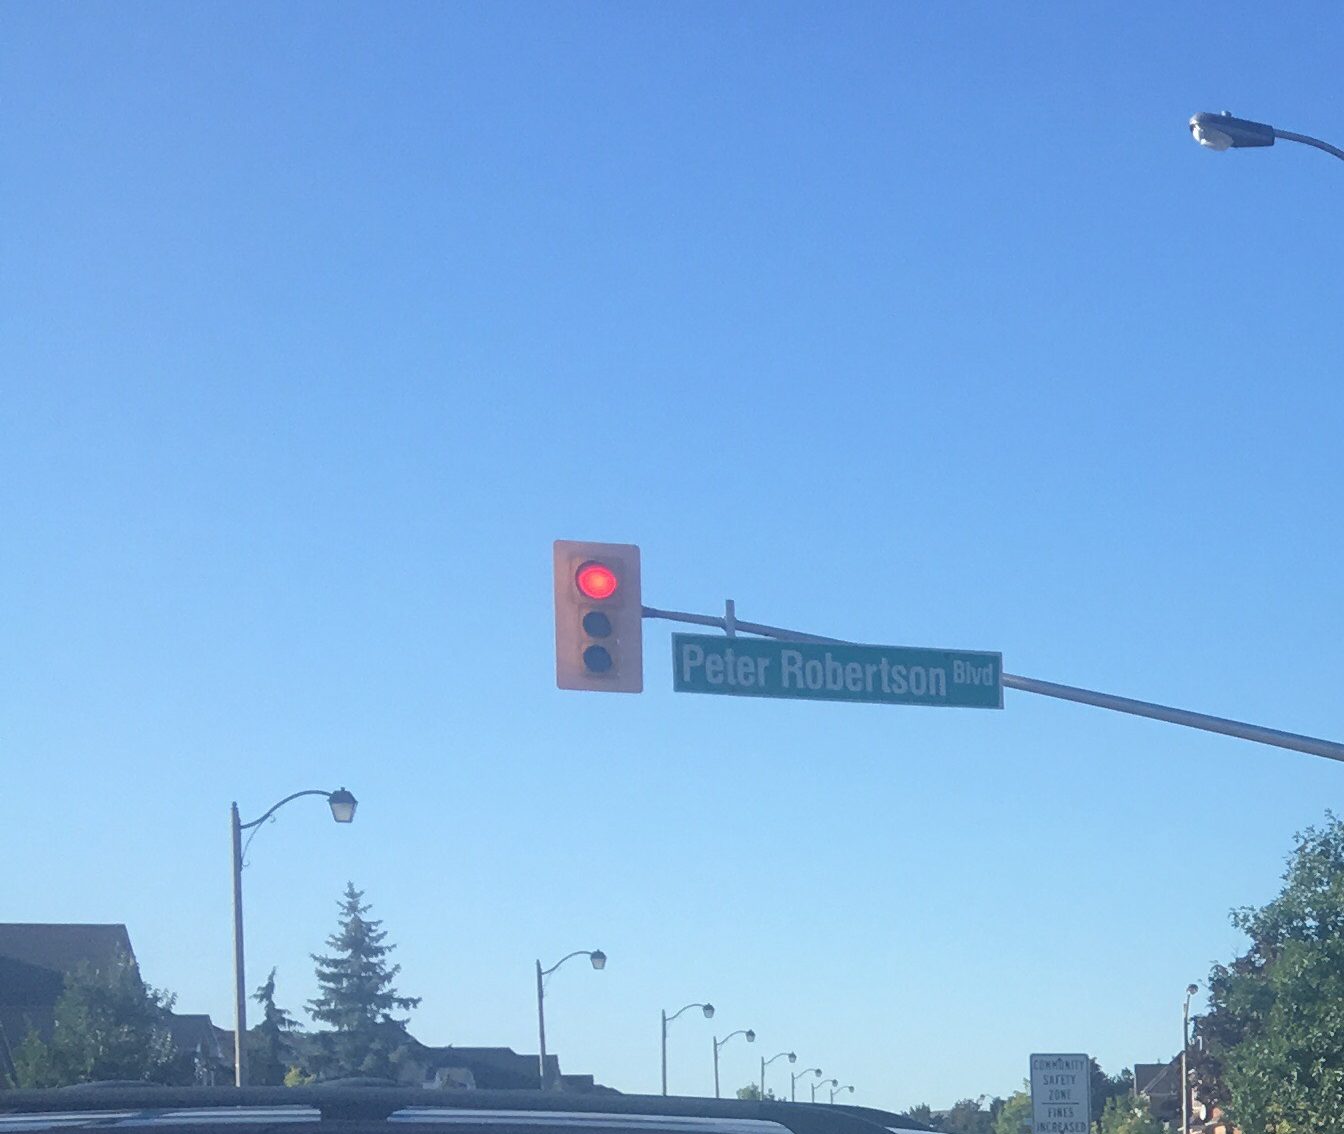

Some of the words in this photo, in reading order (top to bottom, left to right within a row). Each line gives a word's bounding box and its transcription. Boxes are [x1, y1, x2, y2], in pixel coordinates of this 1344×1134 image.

[682, 643, 771, 687] Peter
[781, 649, 947, 697] Robertson
[953, 659, 994, 687] Blvd
[1033, 1060, 1085, 1070] COMMUNITY
[1043, 1074, 1077, 1086] SAFETY
[1048, 1089, 1071, 1101] ZONE
[1048, 1107, 1074, 1118] FINES
[1037, 1121, 1087, 1133] INCREASED
